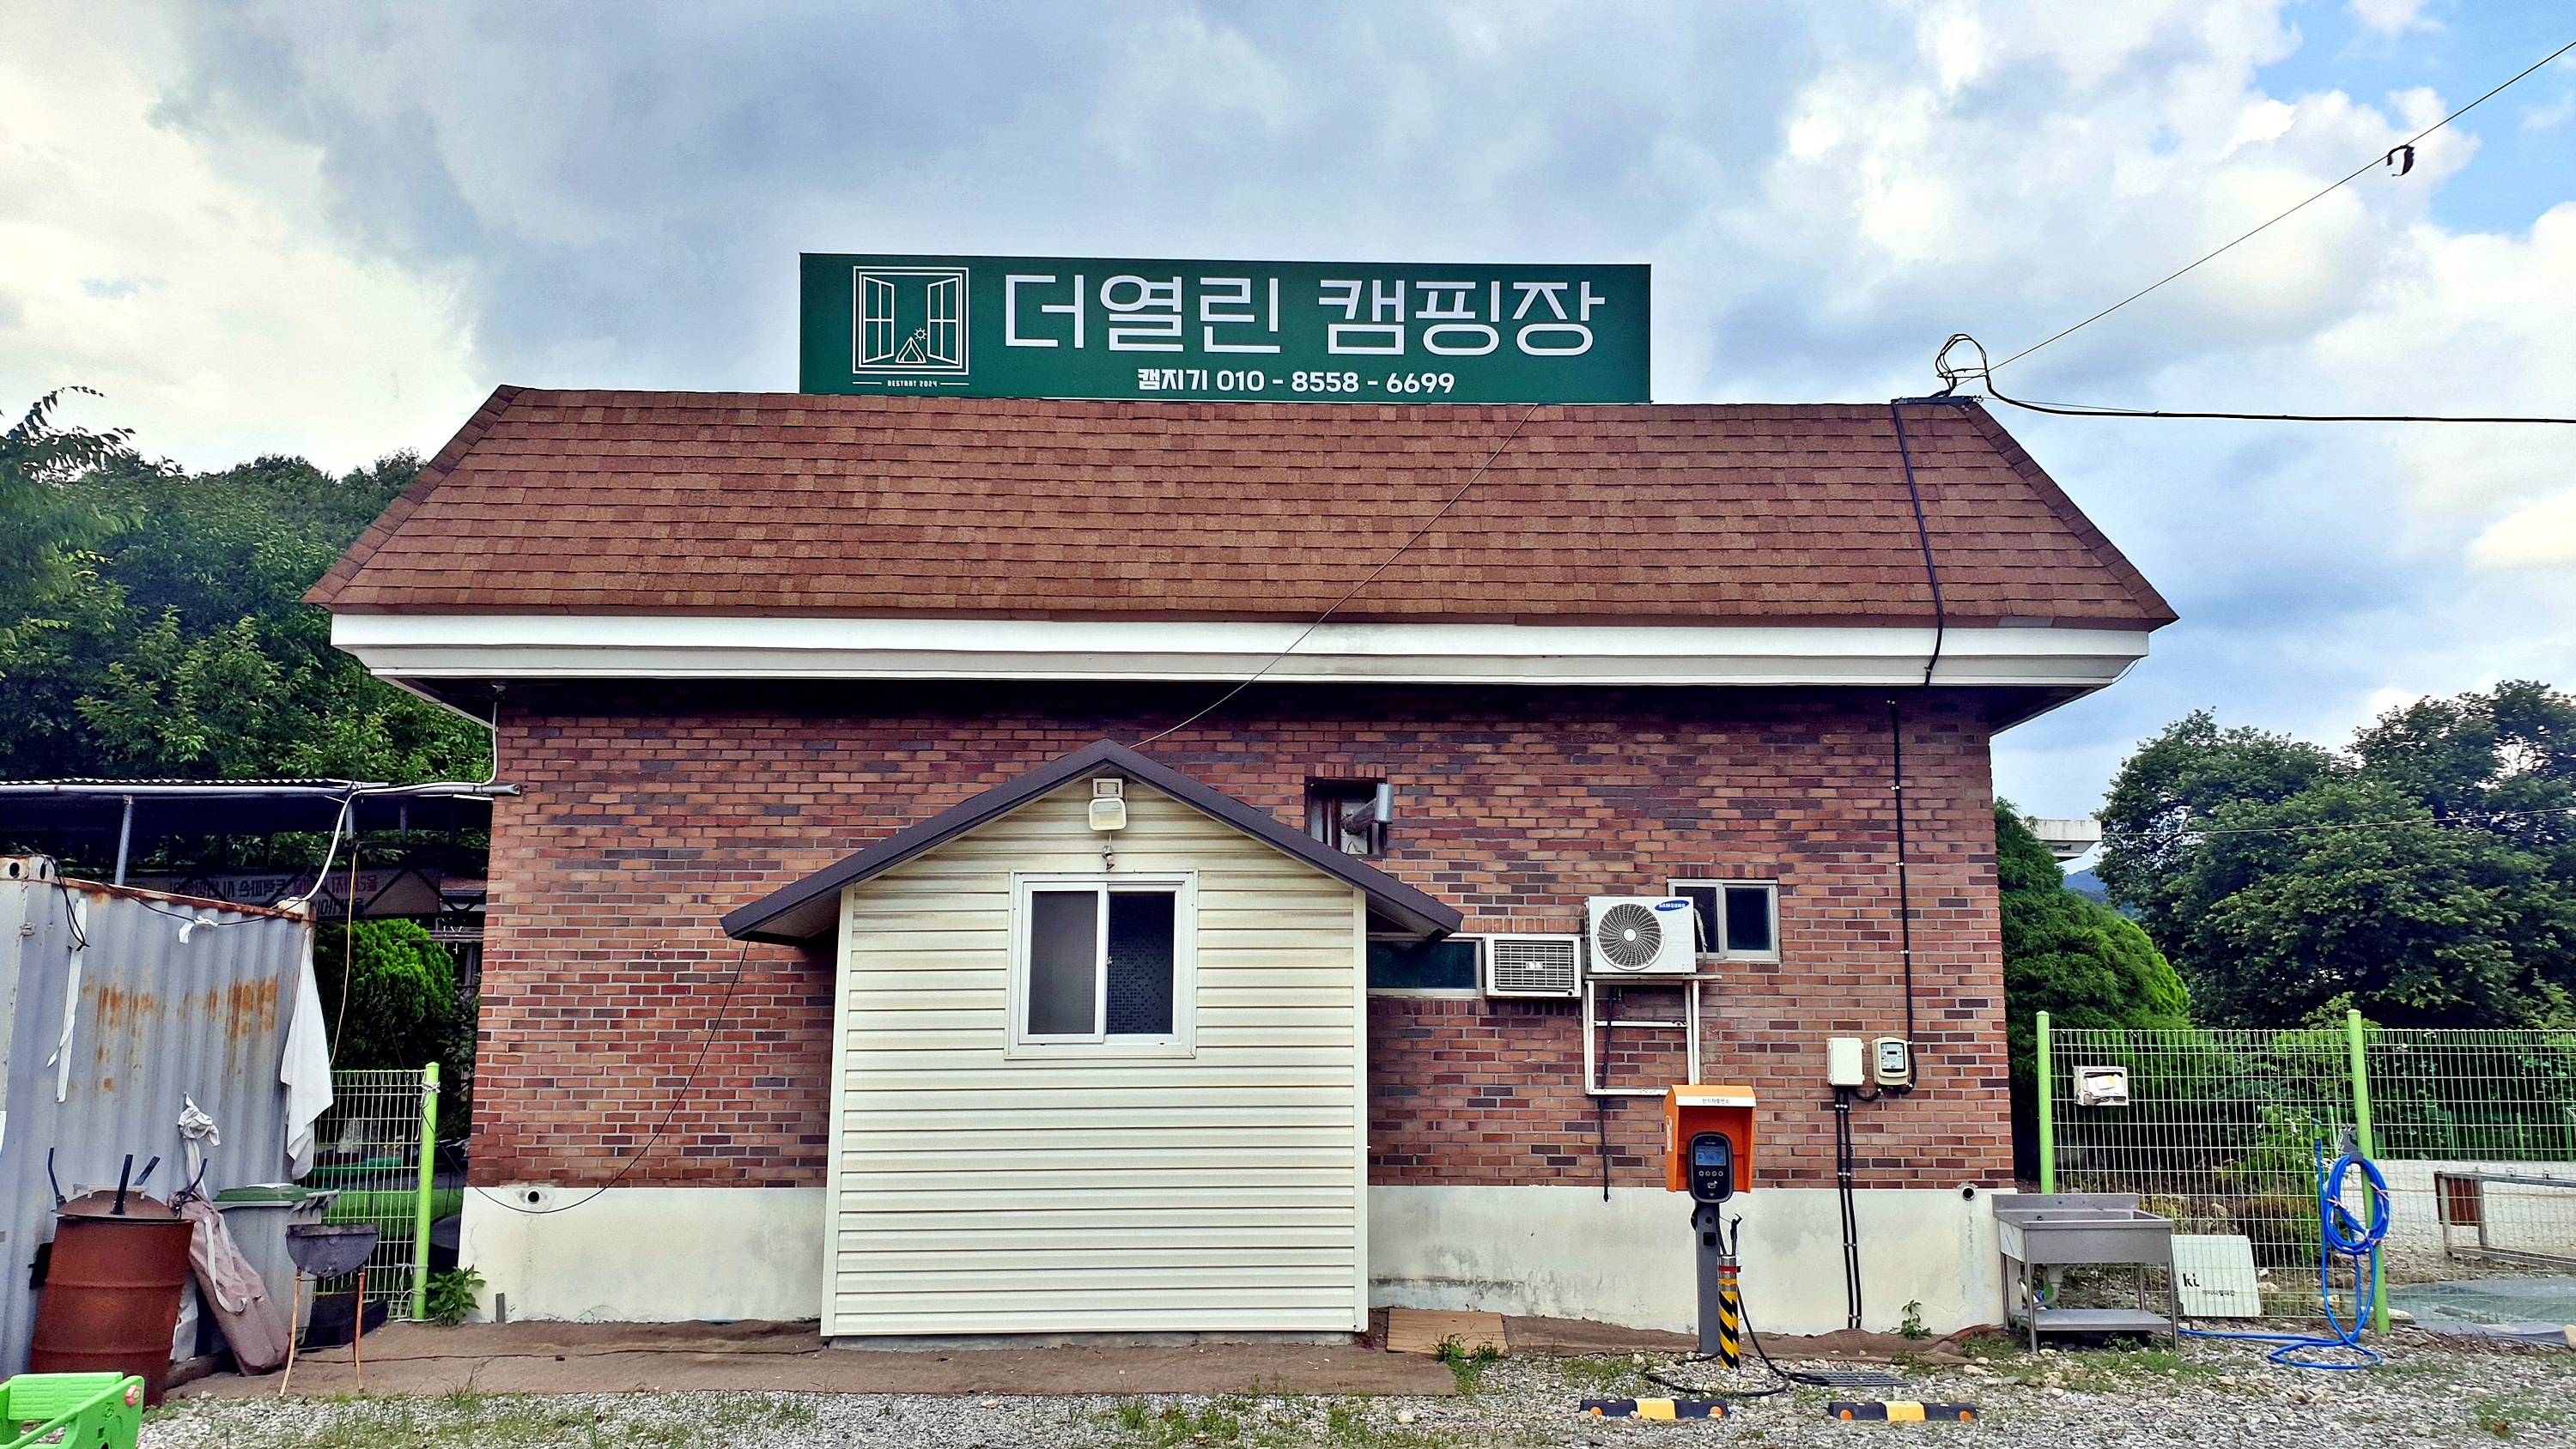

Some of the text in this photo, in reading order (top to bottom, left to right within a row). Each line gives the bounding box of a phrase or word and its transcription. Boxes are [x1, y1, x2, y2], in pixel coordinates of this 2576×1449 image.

[1318, 279, 1606, 356] 캠핑장
[919, 379, 938, 388] 2024
[1137, 368, 1208, 391] 캠지기
[1216, 370, 1266, 392] 010
[1291, 371, 1360, 393] 8558
[1385, 373, 1455, 394] 6699
